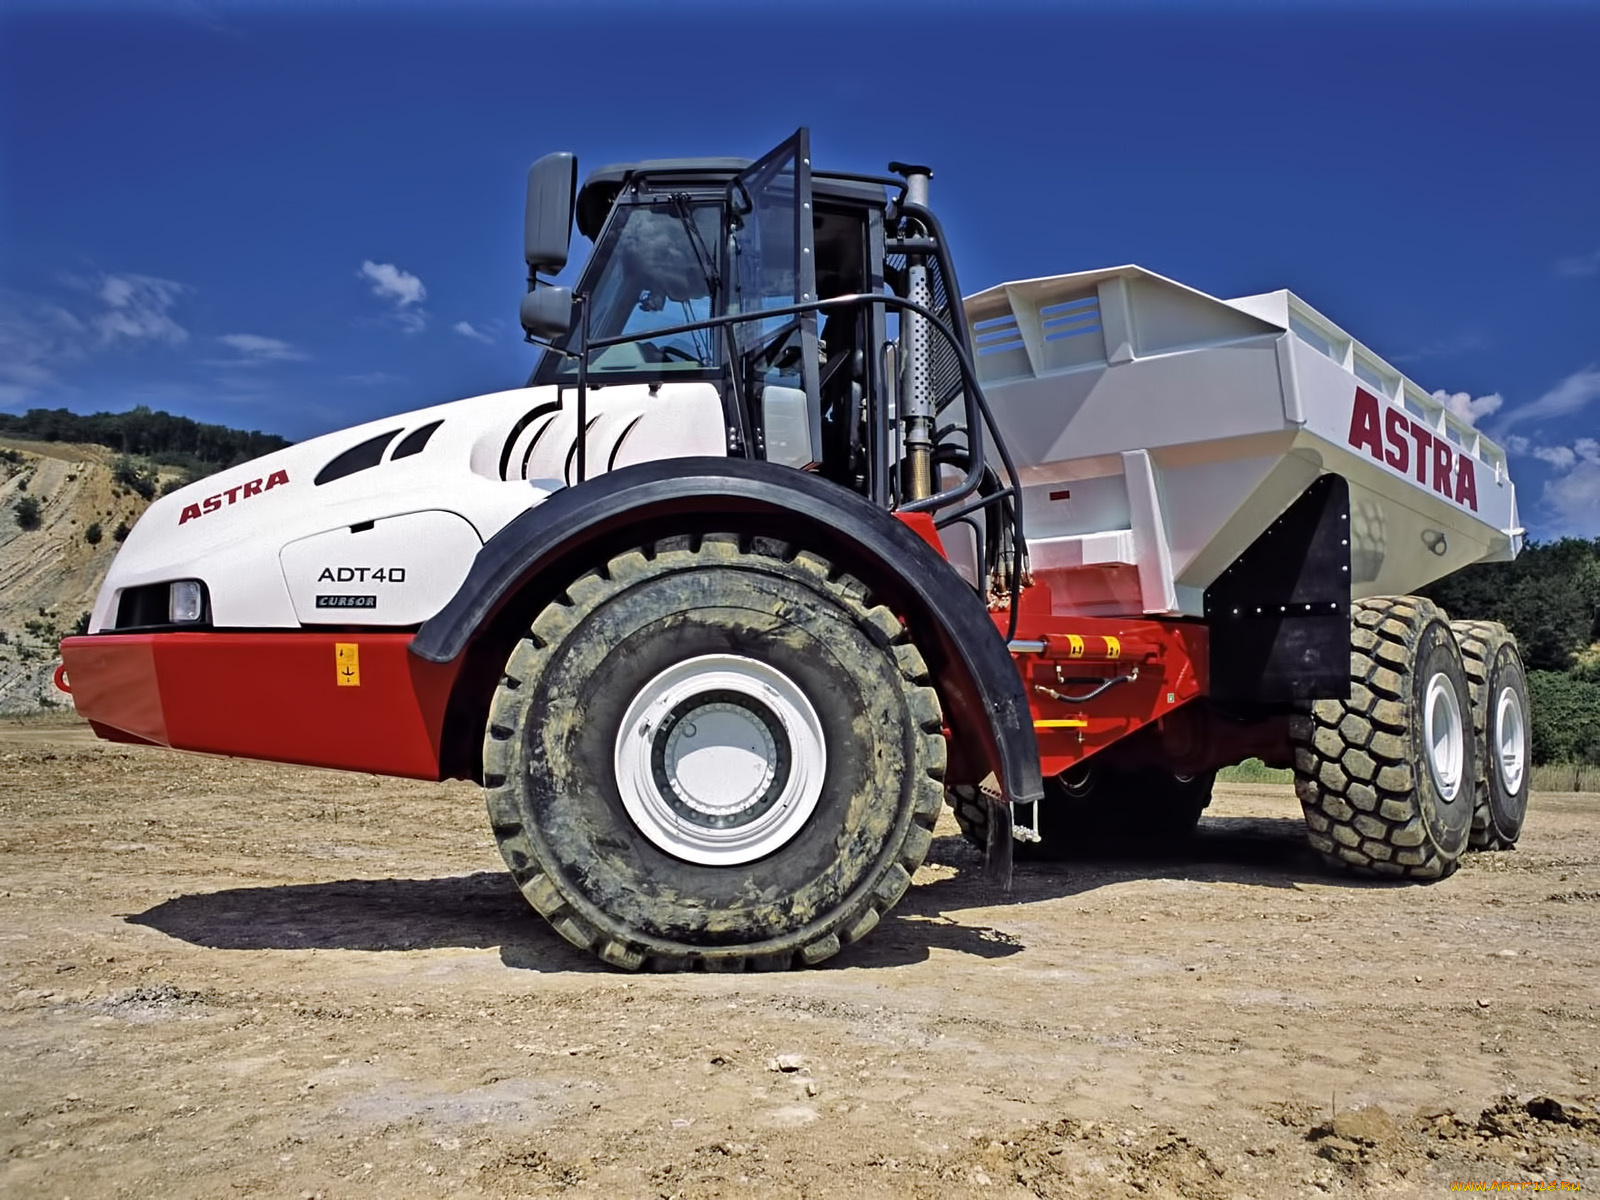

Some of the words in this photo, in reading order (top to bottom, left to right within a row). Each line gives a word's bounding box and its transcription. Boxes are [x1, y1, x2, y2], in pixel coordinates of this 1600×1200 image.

[1348, 385, 1478, 512] ASTRA
[178, 469, 290, 526] ASTRA
[317, 567, 405, 583] ADT40
[319, 597, 375, 606] CURSOR
